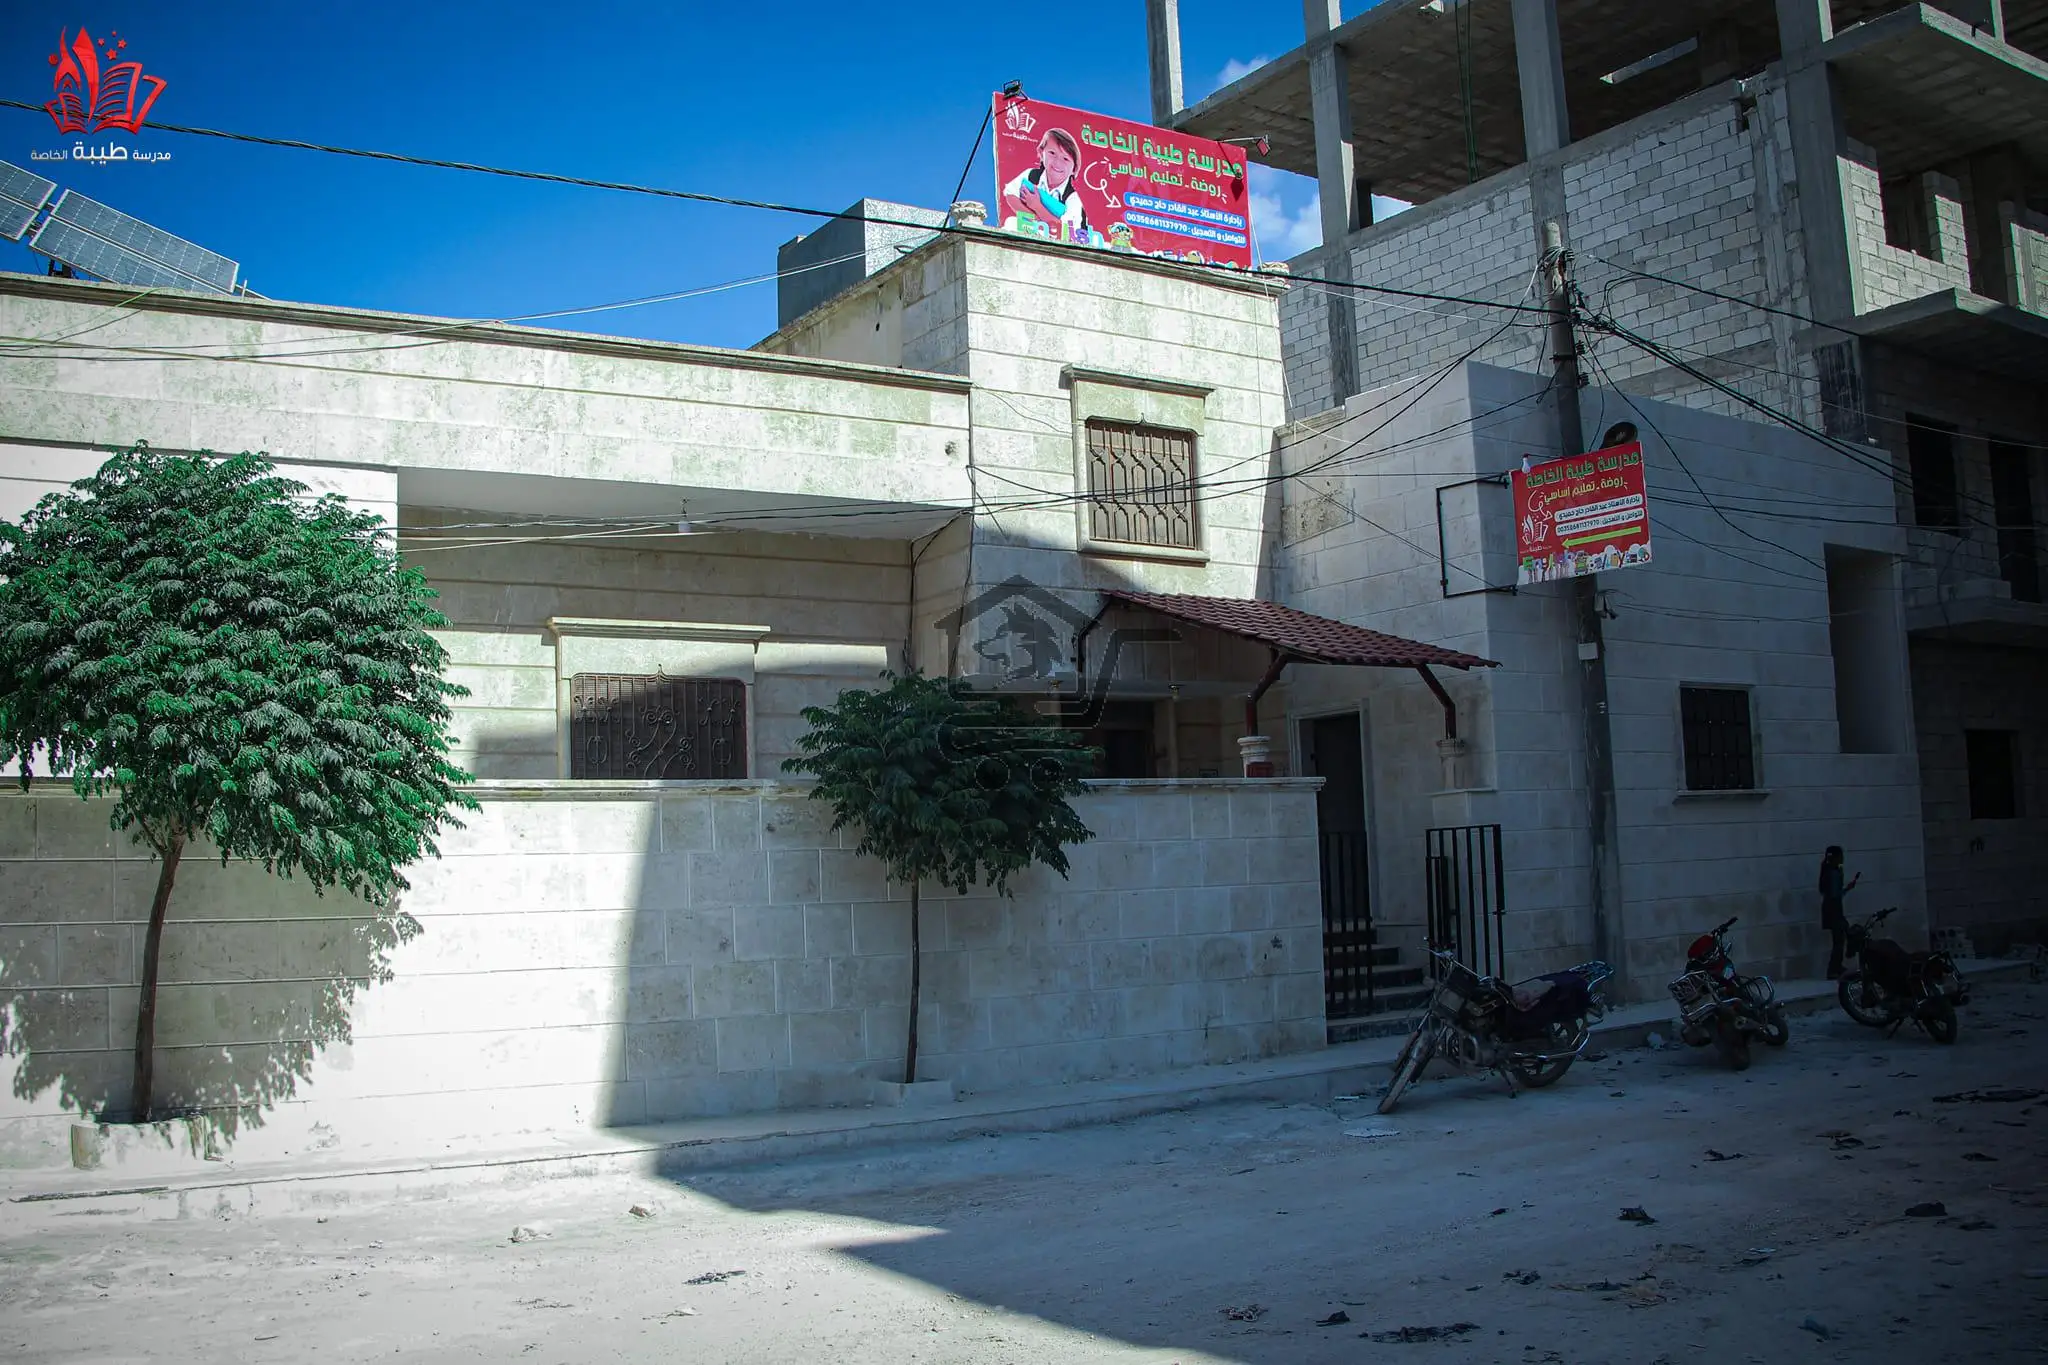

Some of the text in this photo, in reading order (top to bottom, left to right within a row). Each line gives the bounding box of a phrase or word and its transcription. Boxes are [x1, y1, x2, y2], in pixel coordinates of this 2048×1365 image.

[1080, 124, 1244, 179] مدرسة طيبة الخاصة
[1150, 170, 1183, 186] تعليم
[1190, 176, 1221, 197] روضة
[1154, 199, 1167, 210] حاج
[1168, 203, 1187, 214] القادر
[1187, 207, 1200, 217] عبد
[1190, 226, 1216, 238] التسجيل
[1216, 232, 1222, 241] و
[1221, 233, 1246, 244] للتواصل
[1526, 451, 1640, 489] مدرسة طيبة الخاصة
[1600, 476, 1624, 489] روضة
[1572, 480, 1596, 498] تعليم
